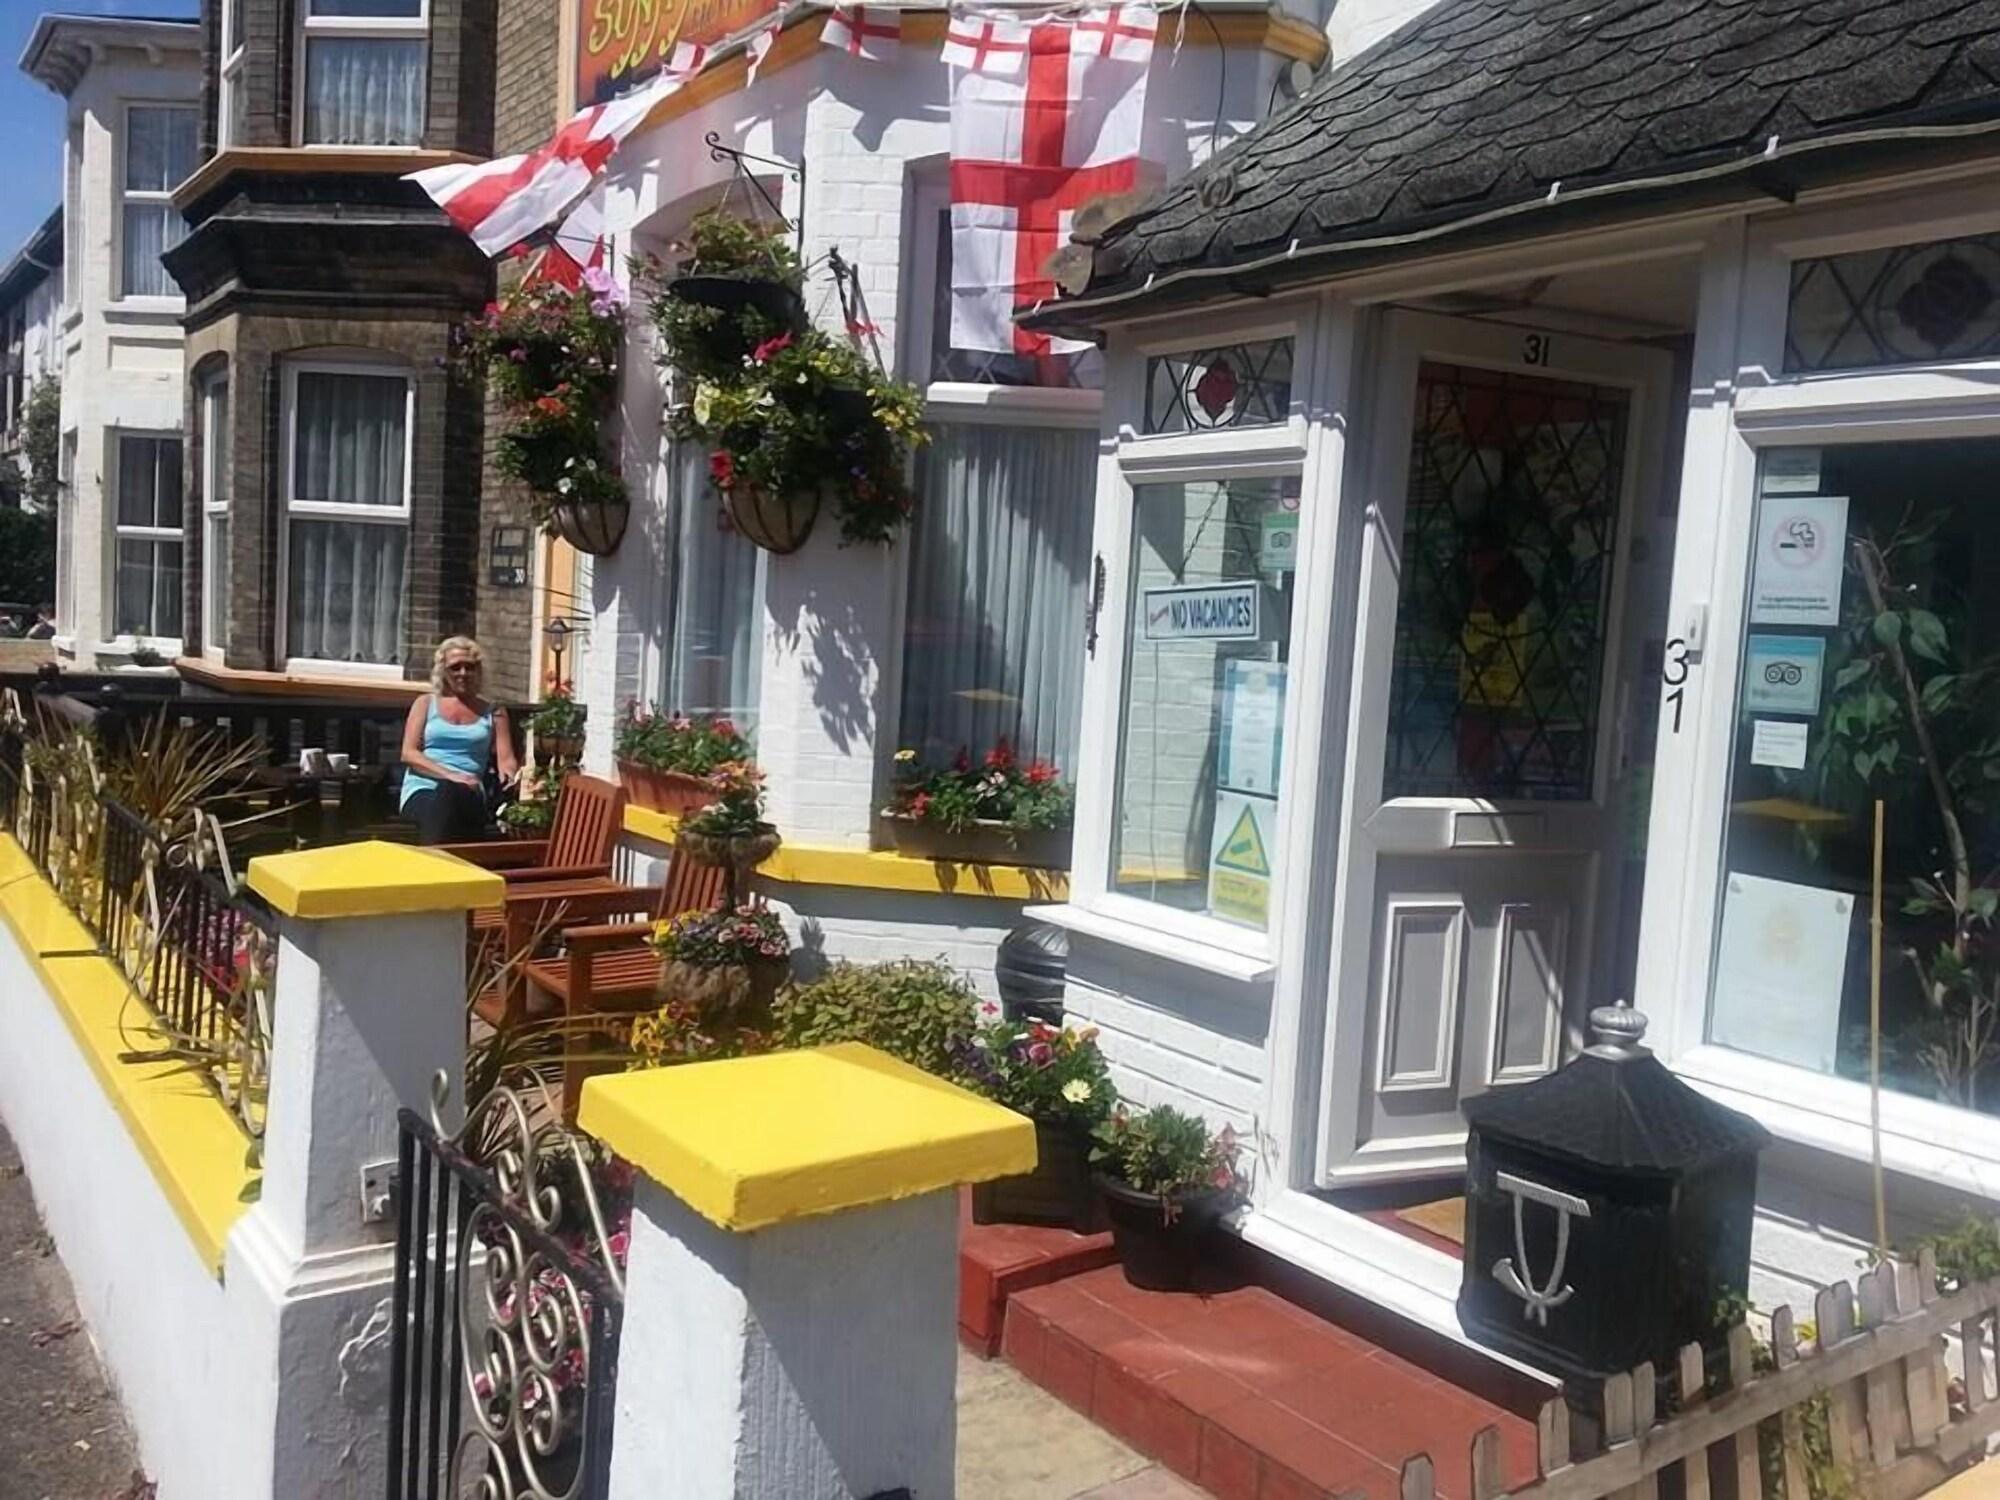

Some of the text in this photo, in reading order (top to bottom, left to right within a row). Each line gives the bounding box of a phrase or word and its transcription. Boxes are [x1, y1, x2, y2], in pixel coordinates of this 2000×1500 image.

[1523, 333, 1550, 367] 31
[1170, 596, 1251, 629] NO VACANCIES
